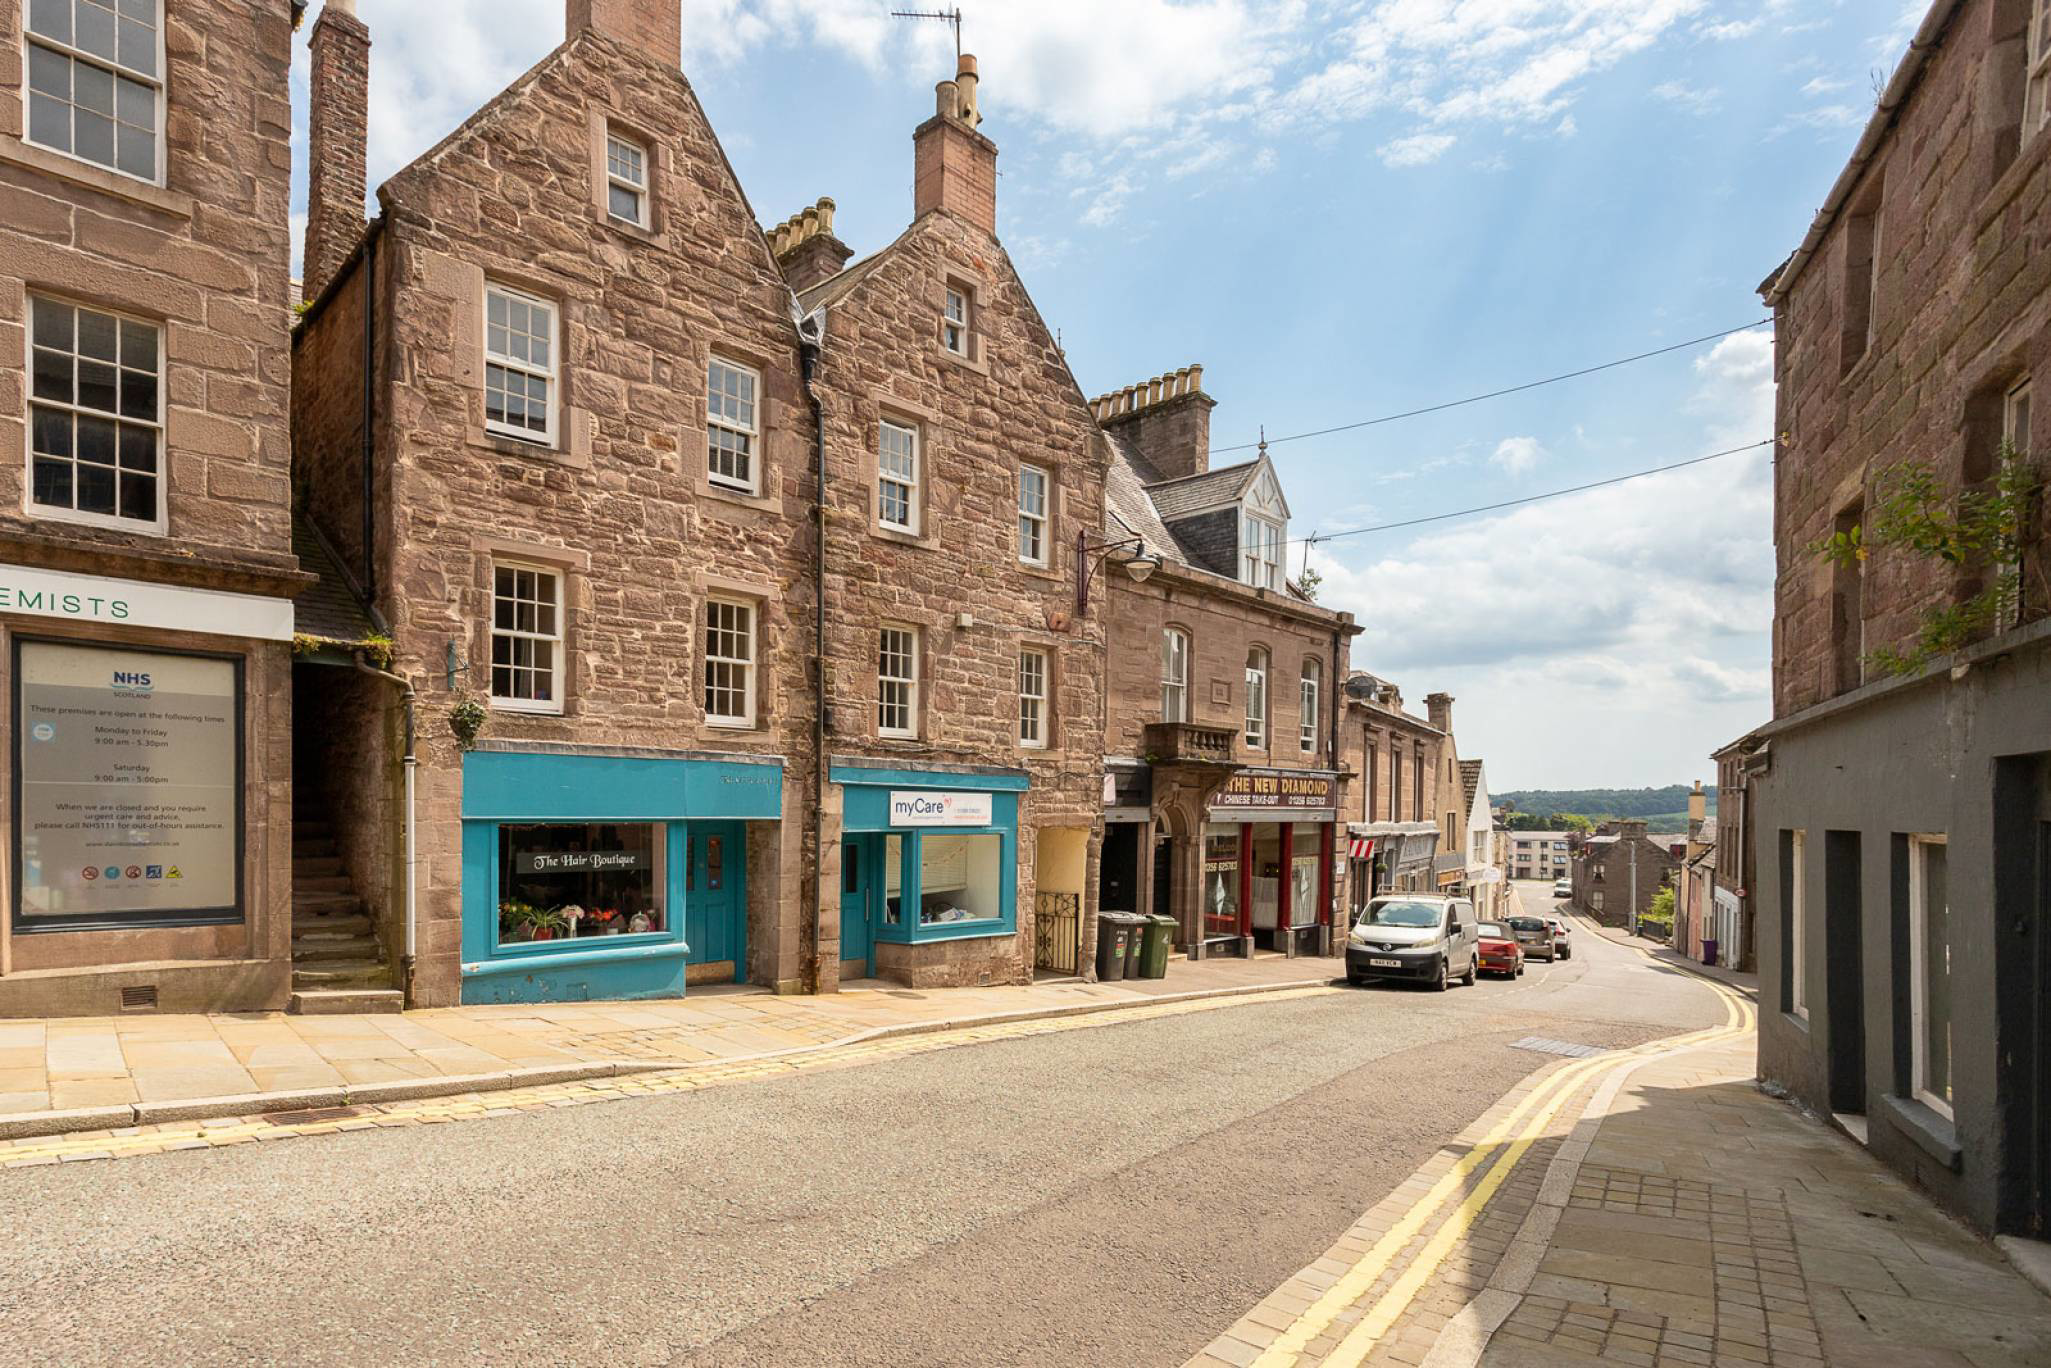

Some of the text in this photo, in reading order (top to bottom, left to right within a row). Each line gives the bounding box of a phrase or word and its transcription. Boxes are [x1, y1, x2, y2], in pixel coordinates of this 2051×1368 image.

[0, 588, 129, 618] EMISTS
[113, 672, 151, 685] NHS
[113, 691, 151, 700] SCOTLAND
[31, 704, 56, 713] These
[58, 707, 96, 716] premises
[165, 713, 202, 722] following
[95, 726, 129, 735] Monday
[143, 728, 168, 737] Friday
[113, 764, 150, 773] Saturday
[1229, 776, 1328, 795] THE NEW DIAMOND
[1224, 795, 1251, 804] CHINESE
[895, 798, 944, 816] myCare
[34, 821, 63, 830] please
[534, 854, 636, 870] The Hair Boutique
